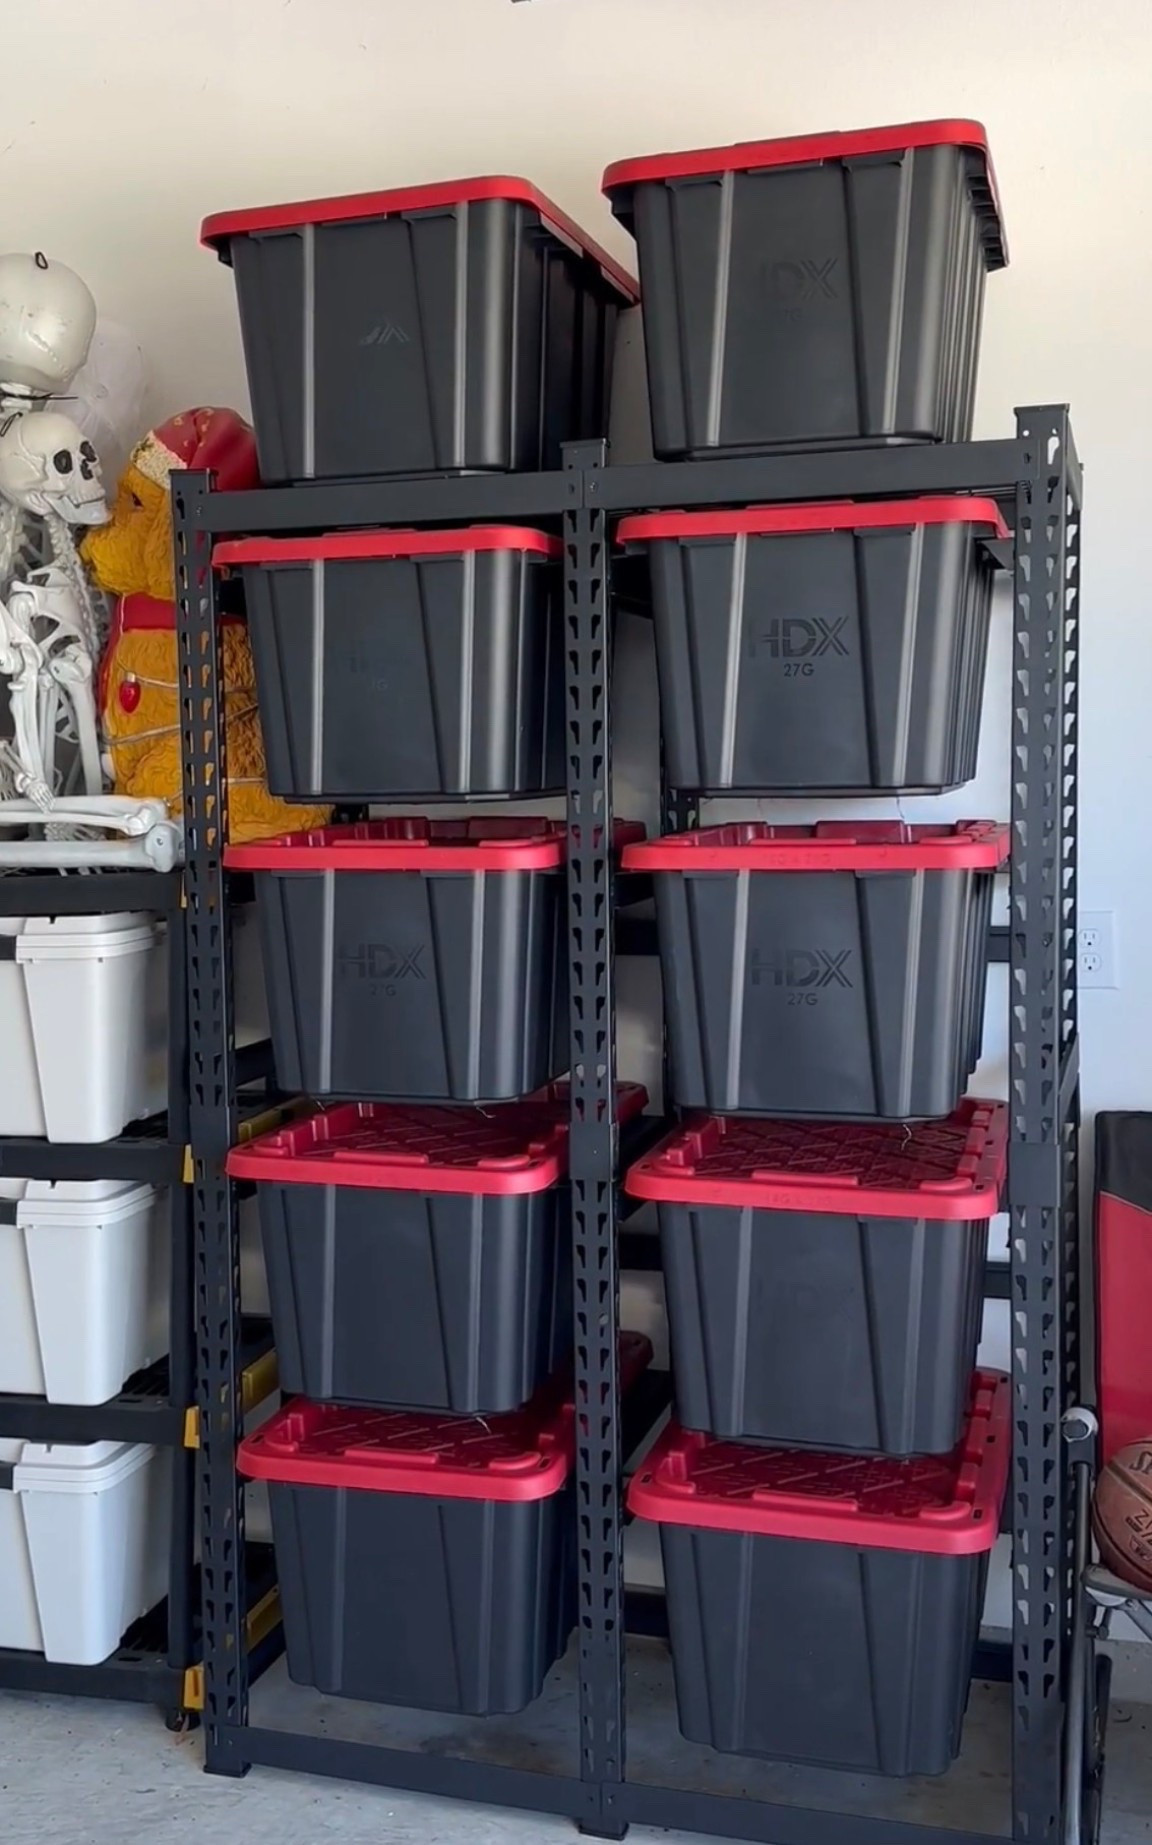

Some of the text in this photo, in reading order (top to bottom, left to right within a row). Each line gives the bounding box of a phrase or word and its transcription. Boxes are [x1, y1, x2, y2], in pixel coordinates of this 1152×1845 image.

[756, 257, 838, 300] DX
[748, 617, 849, 658] HDX
[783, 662, 815, 677] 27G
[338, 943, 427, 980] HDX
[751, 949, 853, 988] HDX
[787, 992, 818, 1006] 27G
